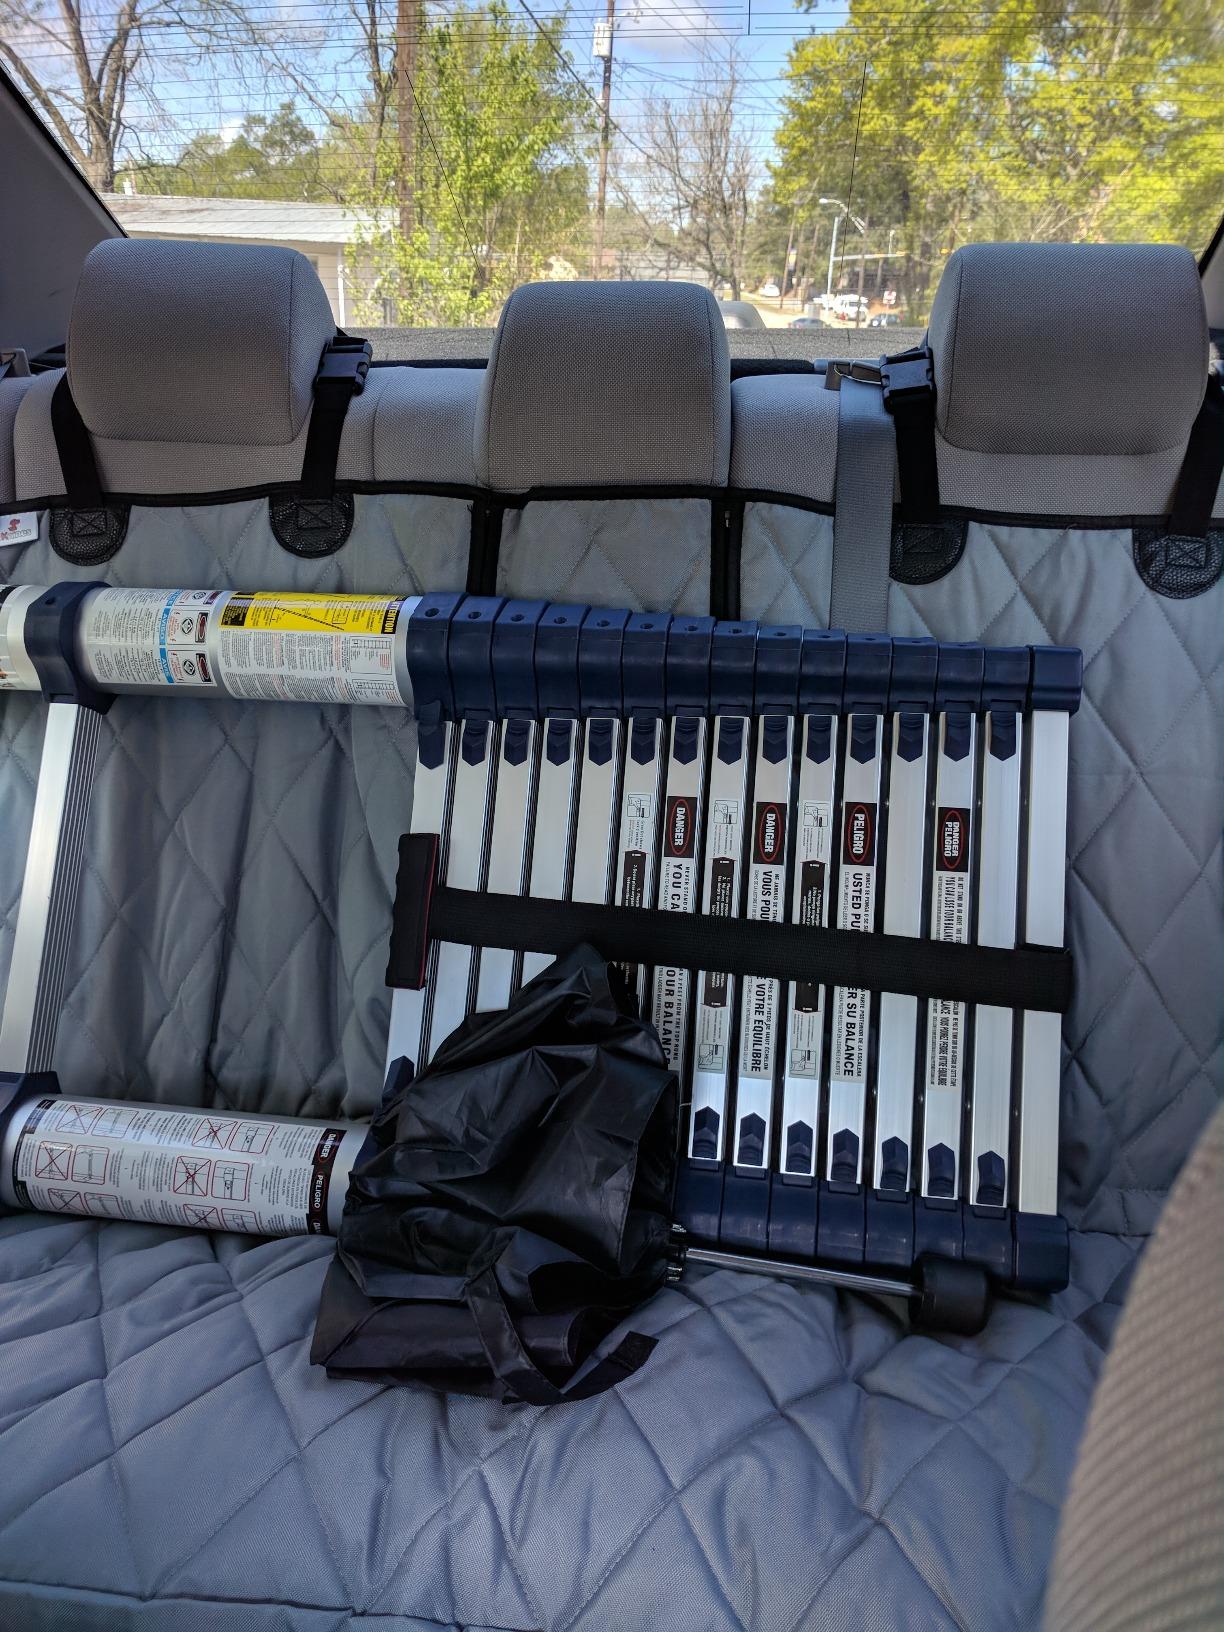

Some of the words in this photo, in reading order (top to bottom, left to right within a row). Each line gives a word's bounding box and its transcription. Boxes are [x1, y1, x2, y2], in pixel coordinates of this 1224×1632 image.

[674, 806, 686, 846] DANGER
[764, 813, 776, 853] DANGER
[852, 813, 865, 854] PELIGRO
[944, 821, 952, 857] PELIGRO
[951, 821, 960, 857] DANGER
[672, 863, 683, 889] YOU
[761, 870, 772, 897] VOUS
[851, 872, 863, 910] USTED
[670, 893, 681, 911] CA
[754, 983, 766, 1016] VOTRE
[846, 1002, 857, 1019] SU
[843, 1022, 856, 1077] BALANCE
[320, 1133, 337, 1158] DANGER
[314, 1174, 324, 1208] PELIGRO
